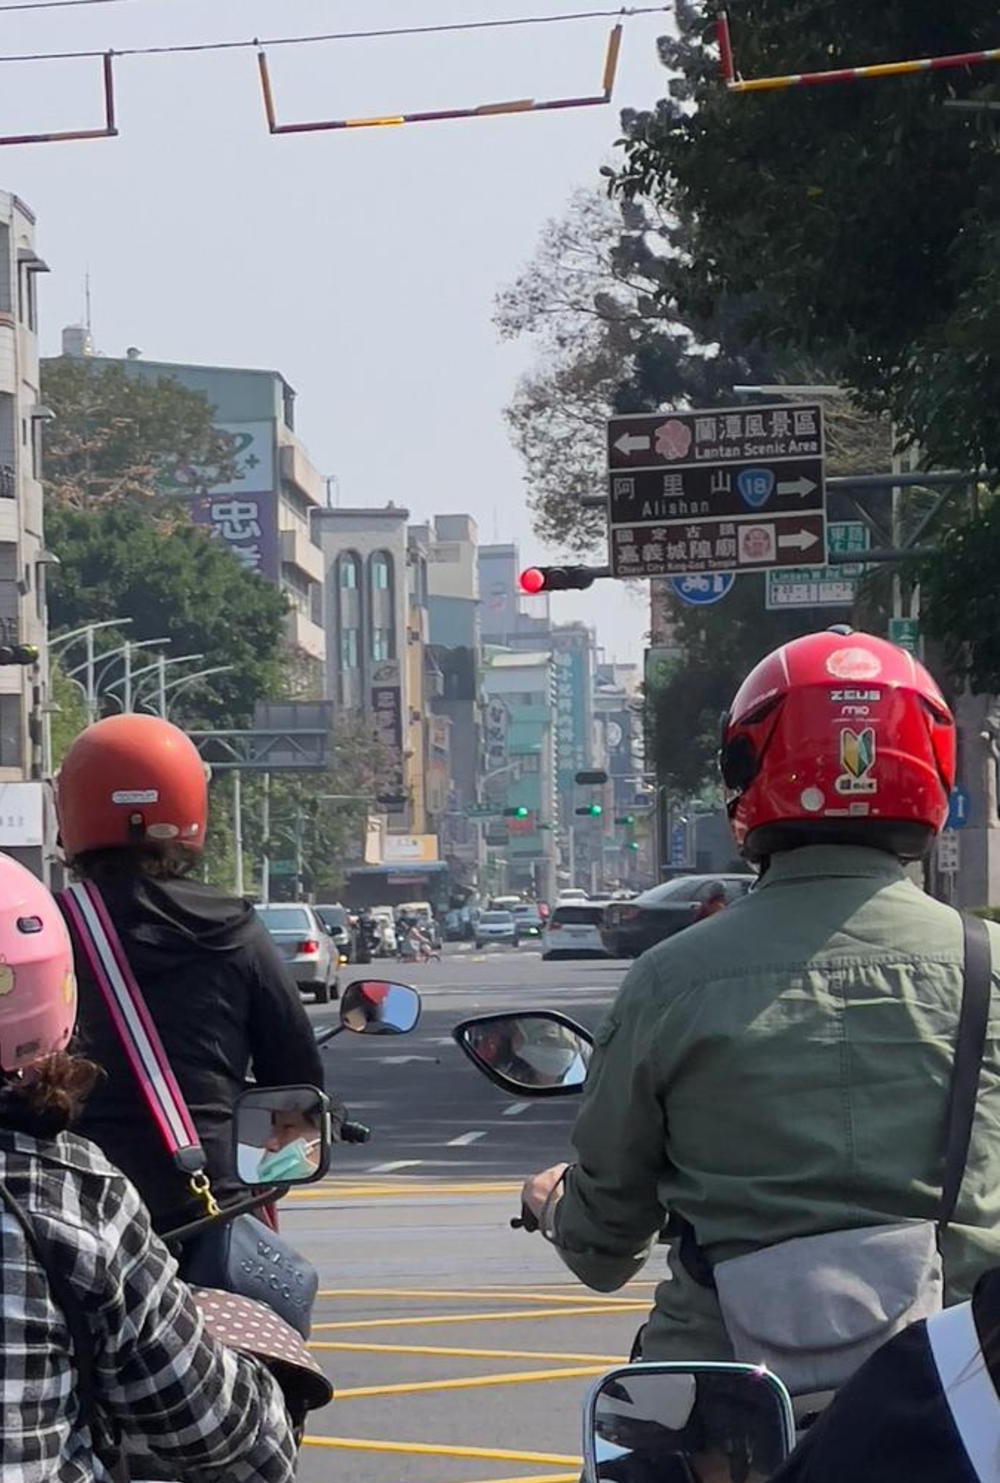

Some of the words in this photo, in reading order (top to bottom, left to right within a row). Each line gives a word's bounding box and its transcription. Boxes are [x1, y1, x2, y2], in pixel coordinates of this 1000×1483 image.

[695, 410, 817, 443] 蘭潭風景區
[695, 446, 740, 459] Lantan
[744, 441, 785, 456] Scenic
[788, 440, 817, 453] Area
[613, 470, 731, 500] 阿里山
[746, 478, 766, 495] 18
[642, 500, 709, 516] Alishan
[617, 539, 736, 564] 嘉義城隍廟
[830, 690, 881, 701] ZEUS
